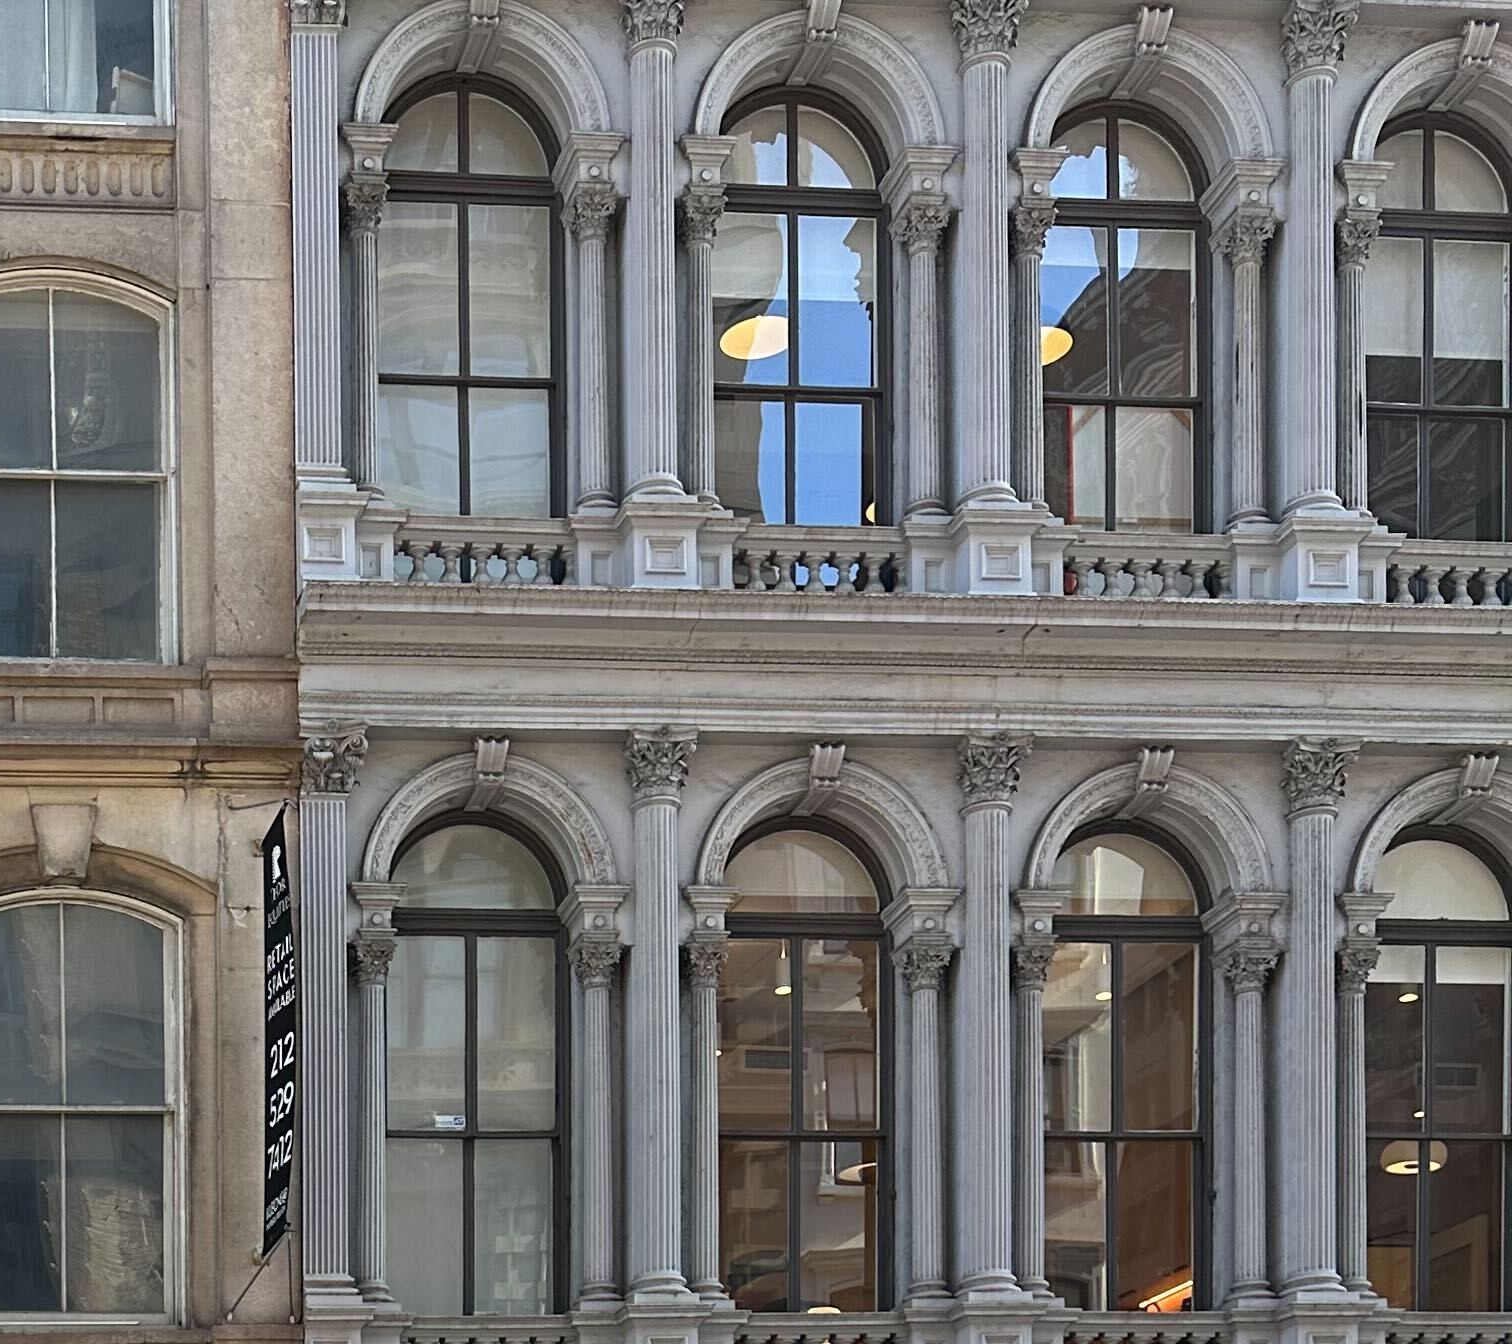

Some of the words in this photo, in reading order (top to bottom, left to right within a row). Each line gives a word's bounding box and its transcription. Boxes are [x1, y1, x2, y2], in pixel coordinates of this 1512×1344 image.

[267, 933, 294, 975] RETAIL
[267, 958, 295, 1000] SPACE
[270, 1031, 295, 1079] 212
[269, 1080, 295, 1128] 529
[267, 1129, 293, 1180] 7412
